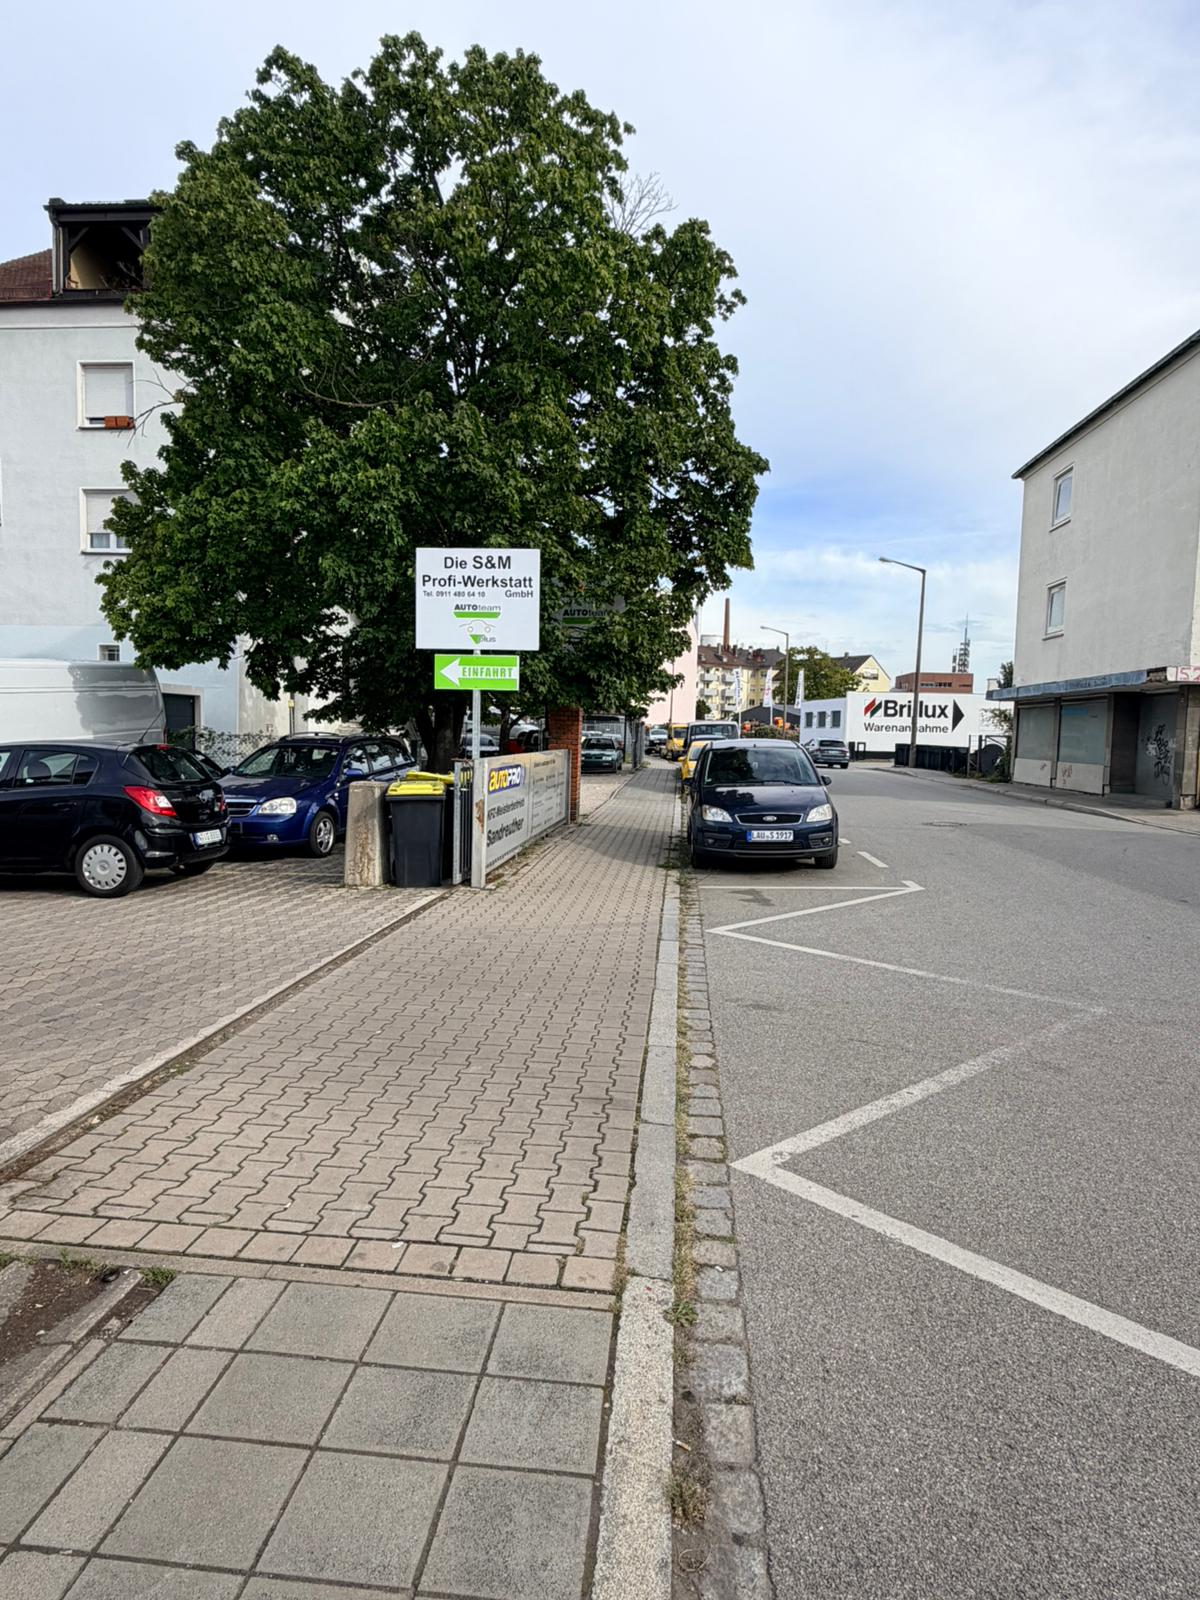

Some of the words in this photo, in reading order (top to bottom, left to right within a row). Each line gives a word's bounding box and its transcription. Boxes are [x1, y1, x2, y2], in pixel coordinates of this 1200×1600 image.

[444, 556, 467, 569] Die
[472, 555, 511, 569] S&M
[422, 574, 533, 588] Profi-Werkstatt
[504, 589, 533, 598] GmbH
[462, 667, 513, 678] EINFAHRT
[883, 700, 949, 718] Brilux
[864, 722, 949, 733] Warenanahme
